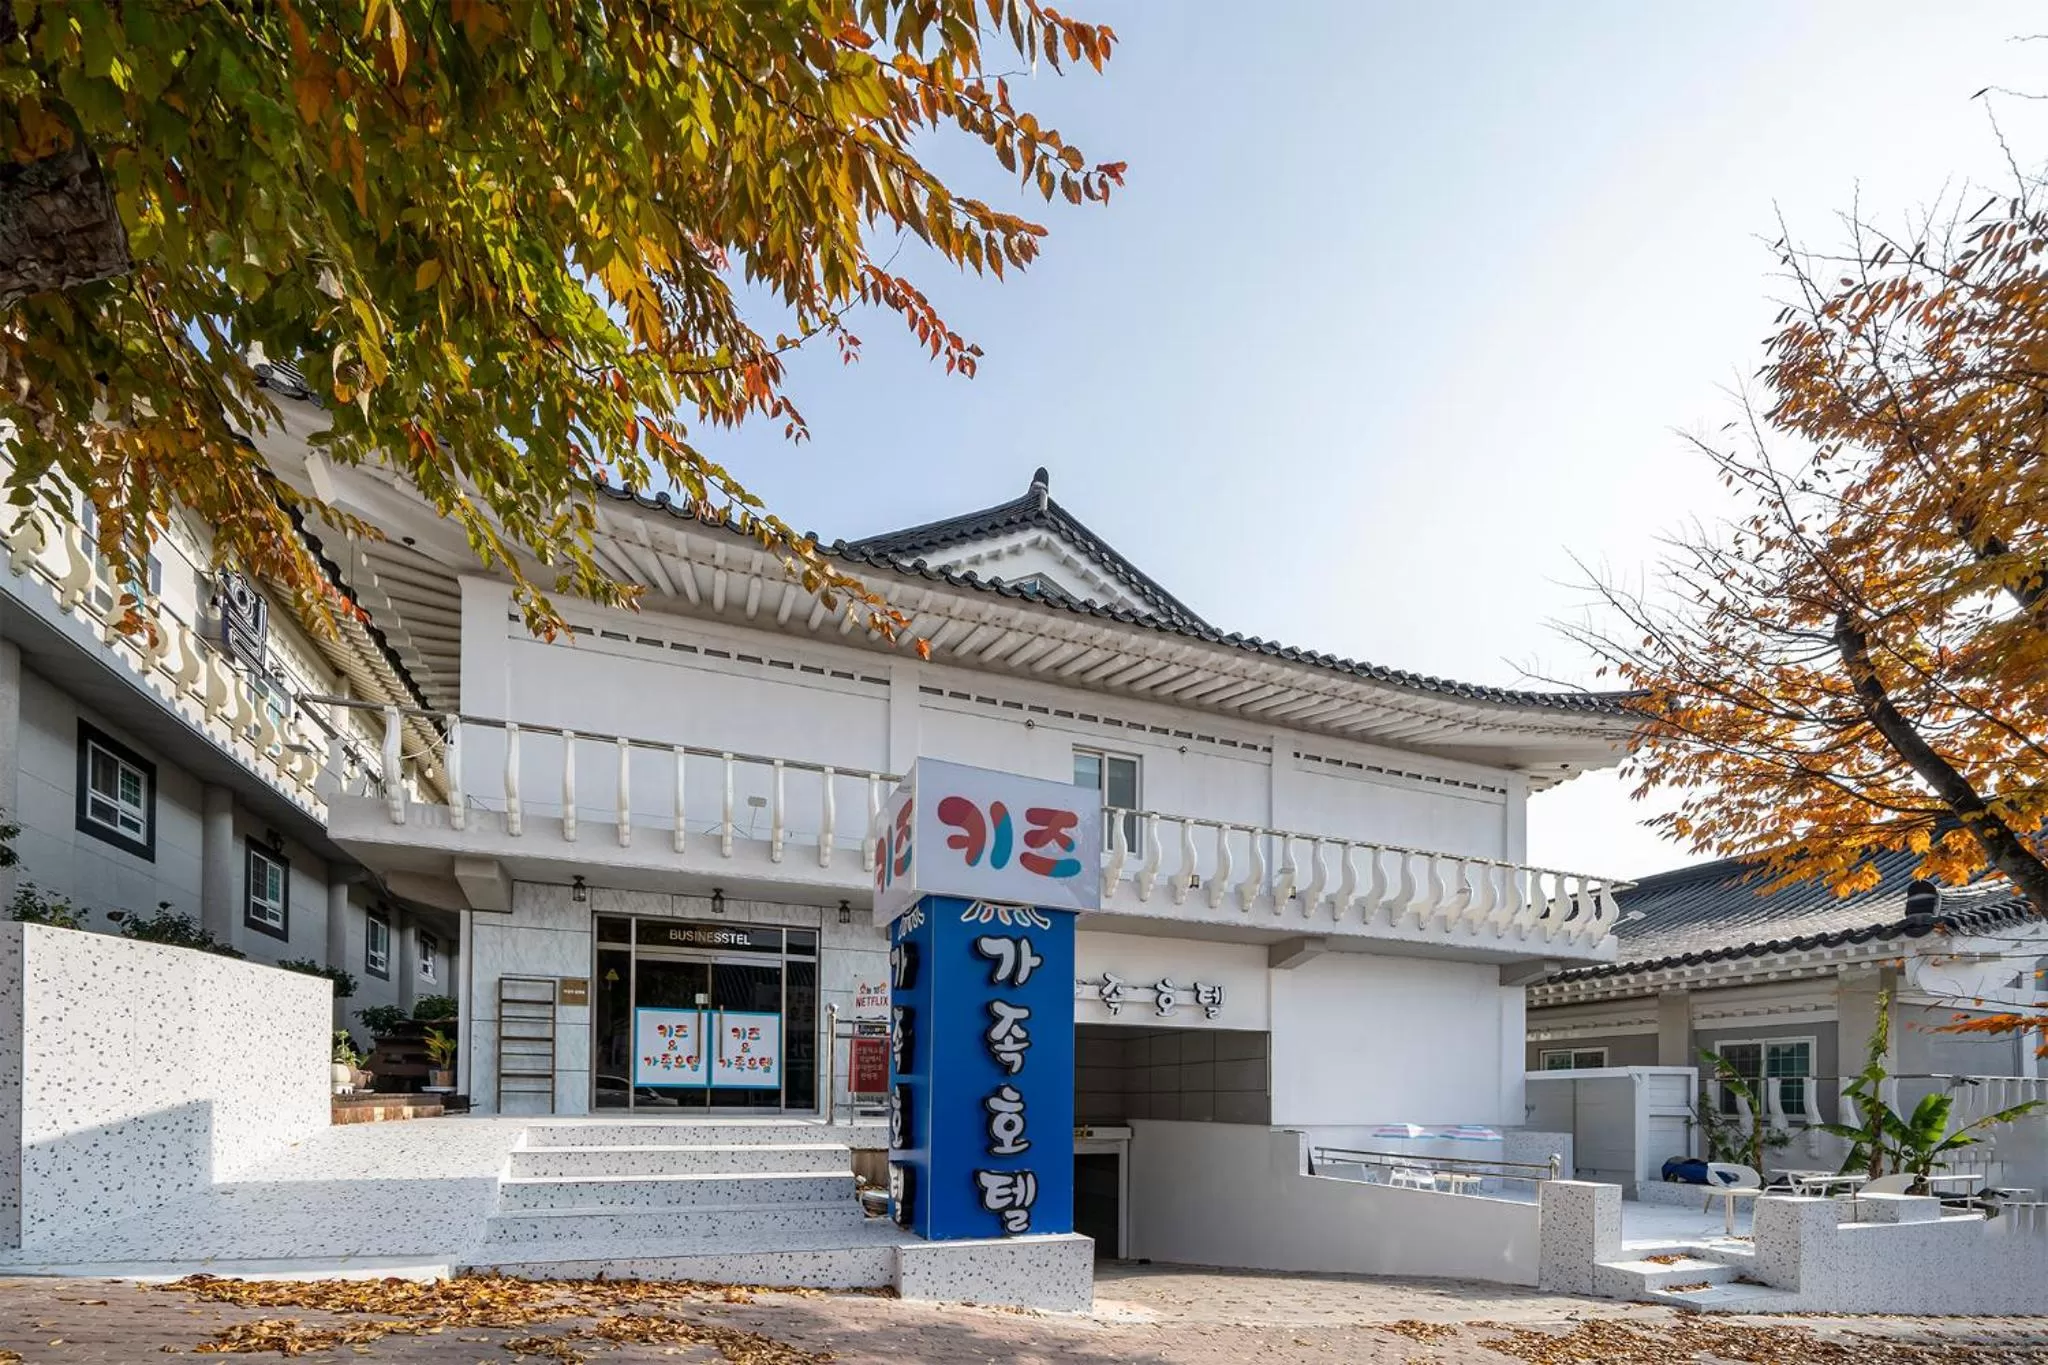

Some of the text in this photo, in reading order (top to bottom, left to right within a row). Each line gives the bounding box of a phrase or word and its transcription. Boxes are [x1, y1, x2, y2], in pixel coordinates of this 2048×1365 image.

[937, 796, 1082, 878] 키즈
[669, 929, 751, 946] BUSINESSTEL
[856, 996, 888, 1008] NETFLIX
[657, 1024, 688, 1038] 키즈
[731, 1027, 760, 1040] 키즈
[668, 1040, 678, 1051] &
[741, 1042, 750, 1053] &
[644, 1053, 700, 1072] 가족호텔
[719, 1055, 773, 1073] 가족호텔
[974, 934, 1043, 1237] 가족호텔
